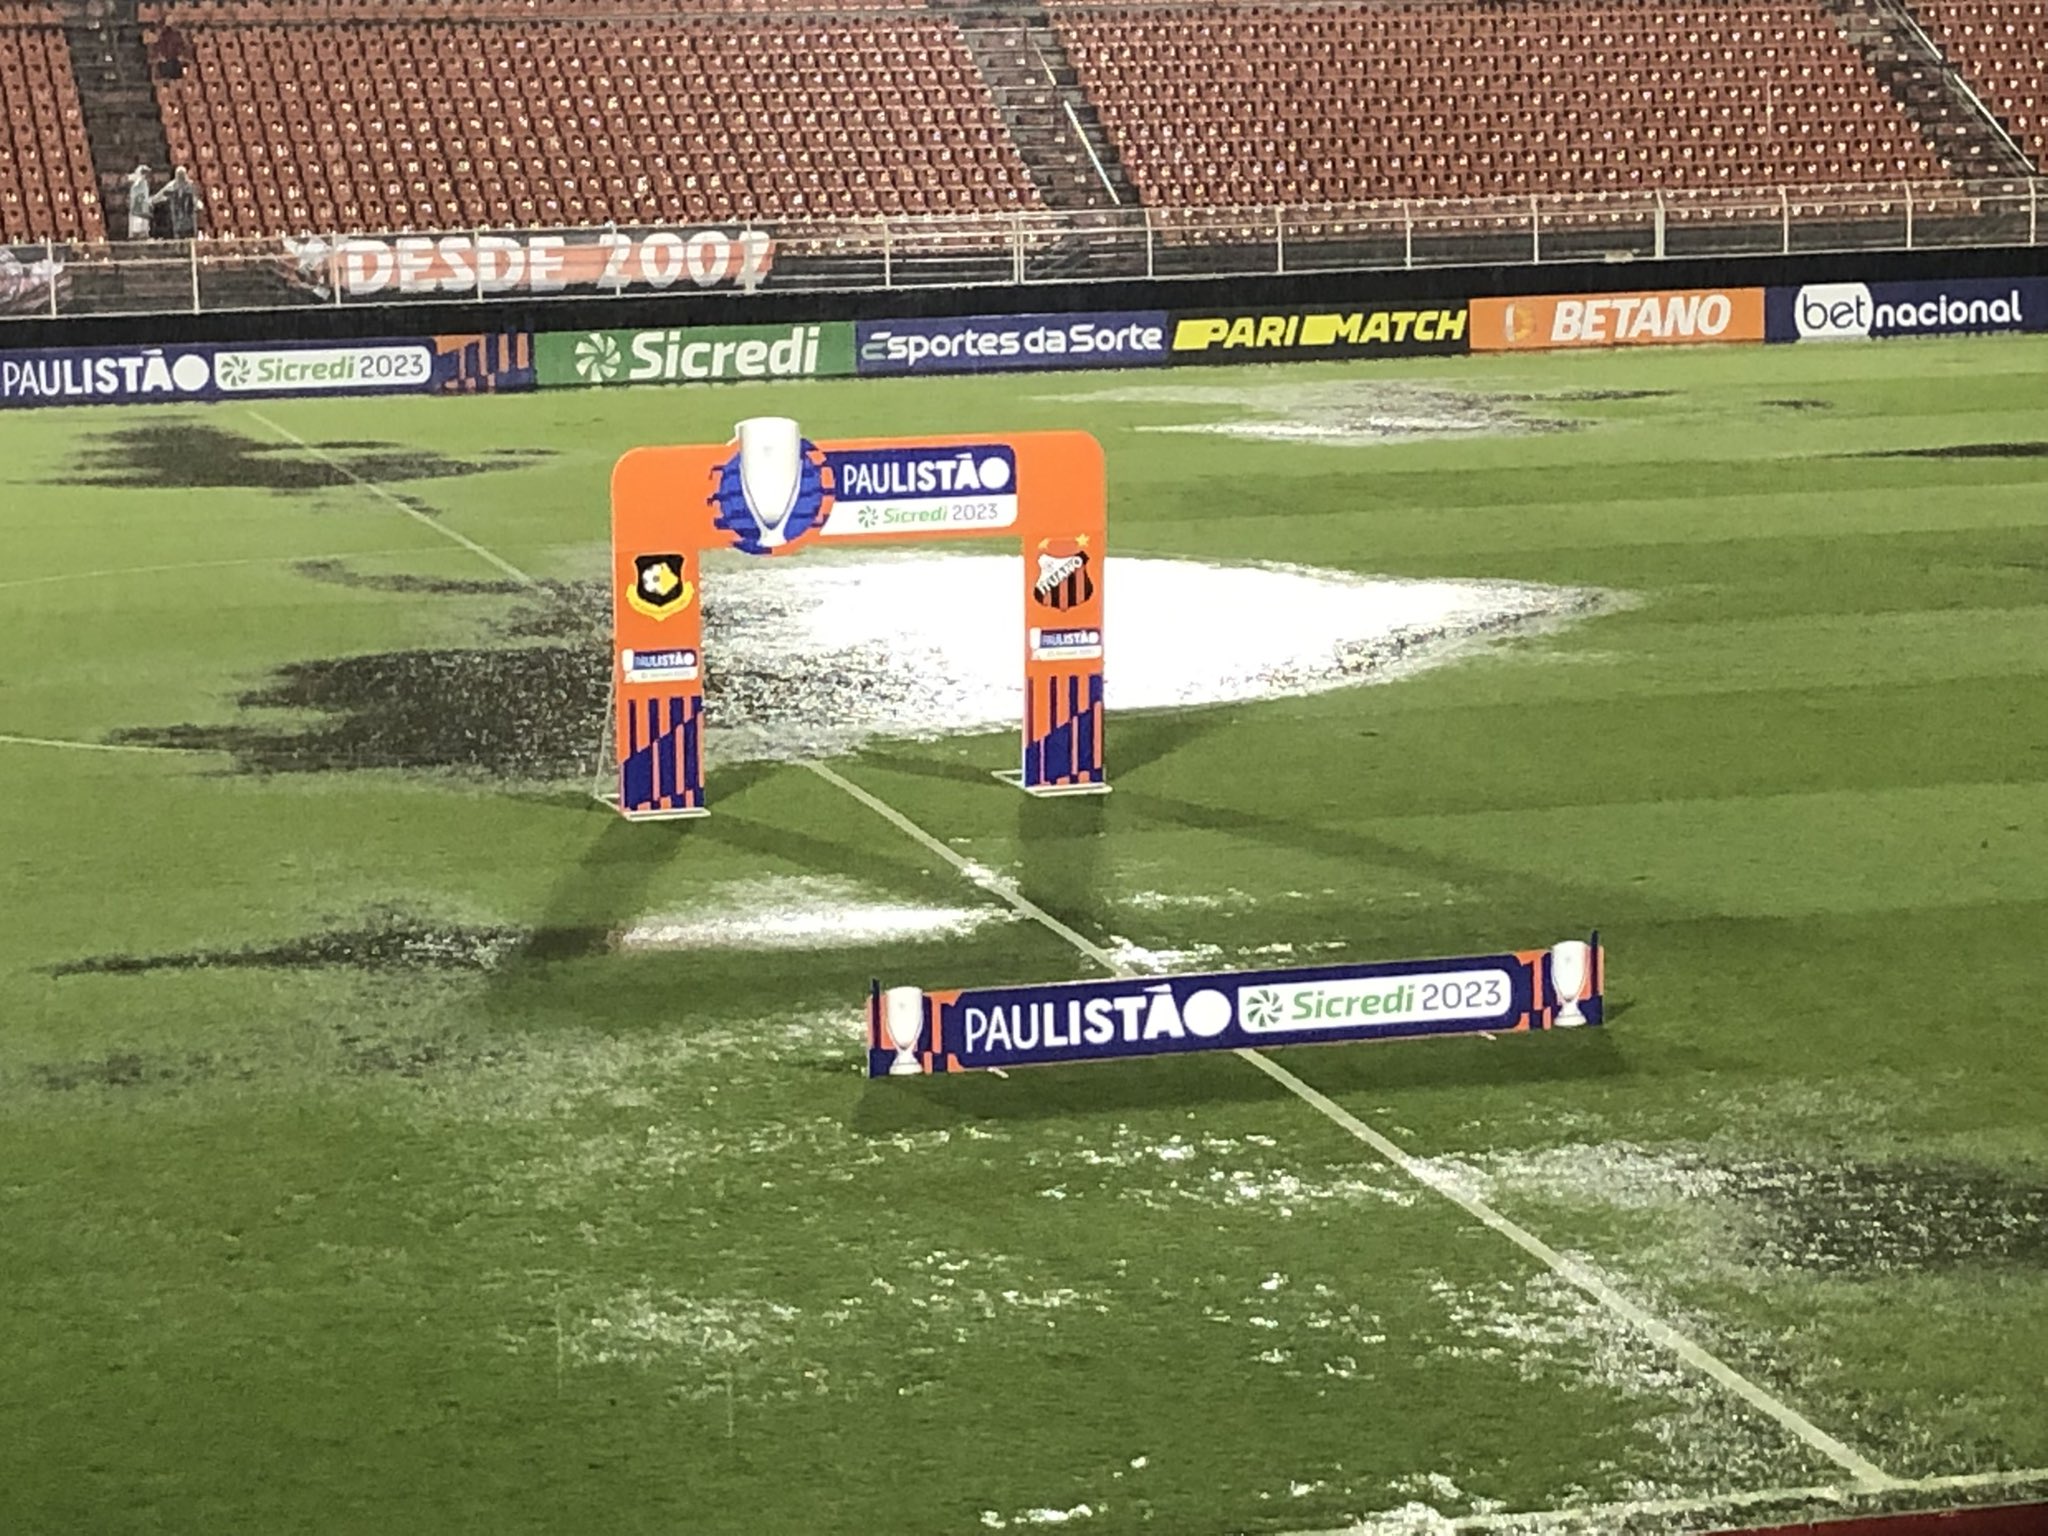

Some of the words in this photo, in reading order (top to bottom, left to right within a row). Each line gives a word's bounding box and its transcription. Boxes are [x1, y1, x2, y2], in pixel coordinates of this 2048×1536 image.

[336, 236, 567, 295] DESDE
[1550, 294, 1732, 341] BETANO
[1803, 293, 1866, 330] bet
[1875, 289, 2023, 328] nacional
[629, 326, 821, 380] Sicredi
[861, 328, 1020, 366] Esportes
[1023, 326, 1066, 352] da
[1069, 322, 1163, 353] Sorte
[2, 348, 210, 397] PAULISTÃO
[257, 355, 355, 382] Sicredi
[359, 353, 424, 378] 2023
[843, 452, 1010, 495] PAULISTÃO
[883, 506, 948, 525] Sicredi
[952, 503, 998, 521] 2023
[965, 983, 1232, 1053] PAULISTÃO
[1291, 984, 1416, 1020] Sicredi
[1421, 980, 1502, 1011] 2023
